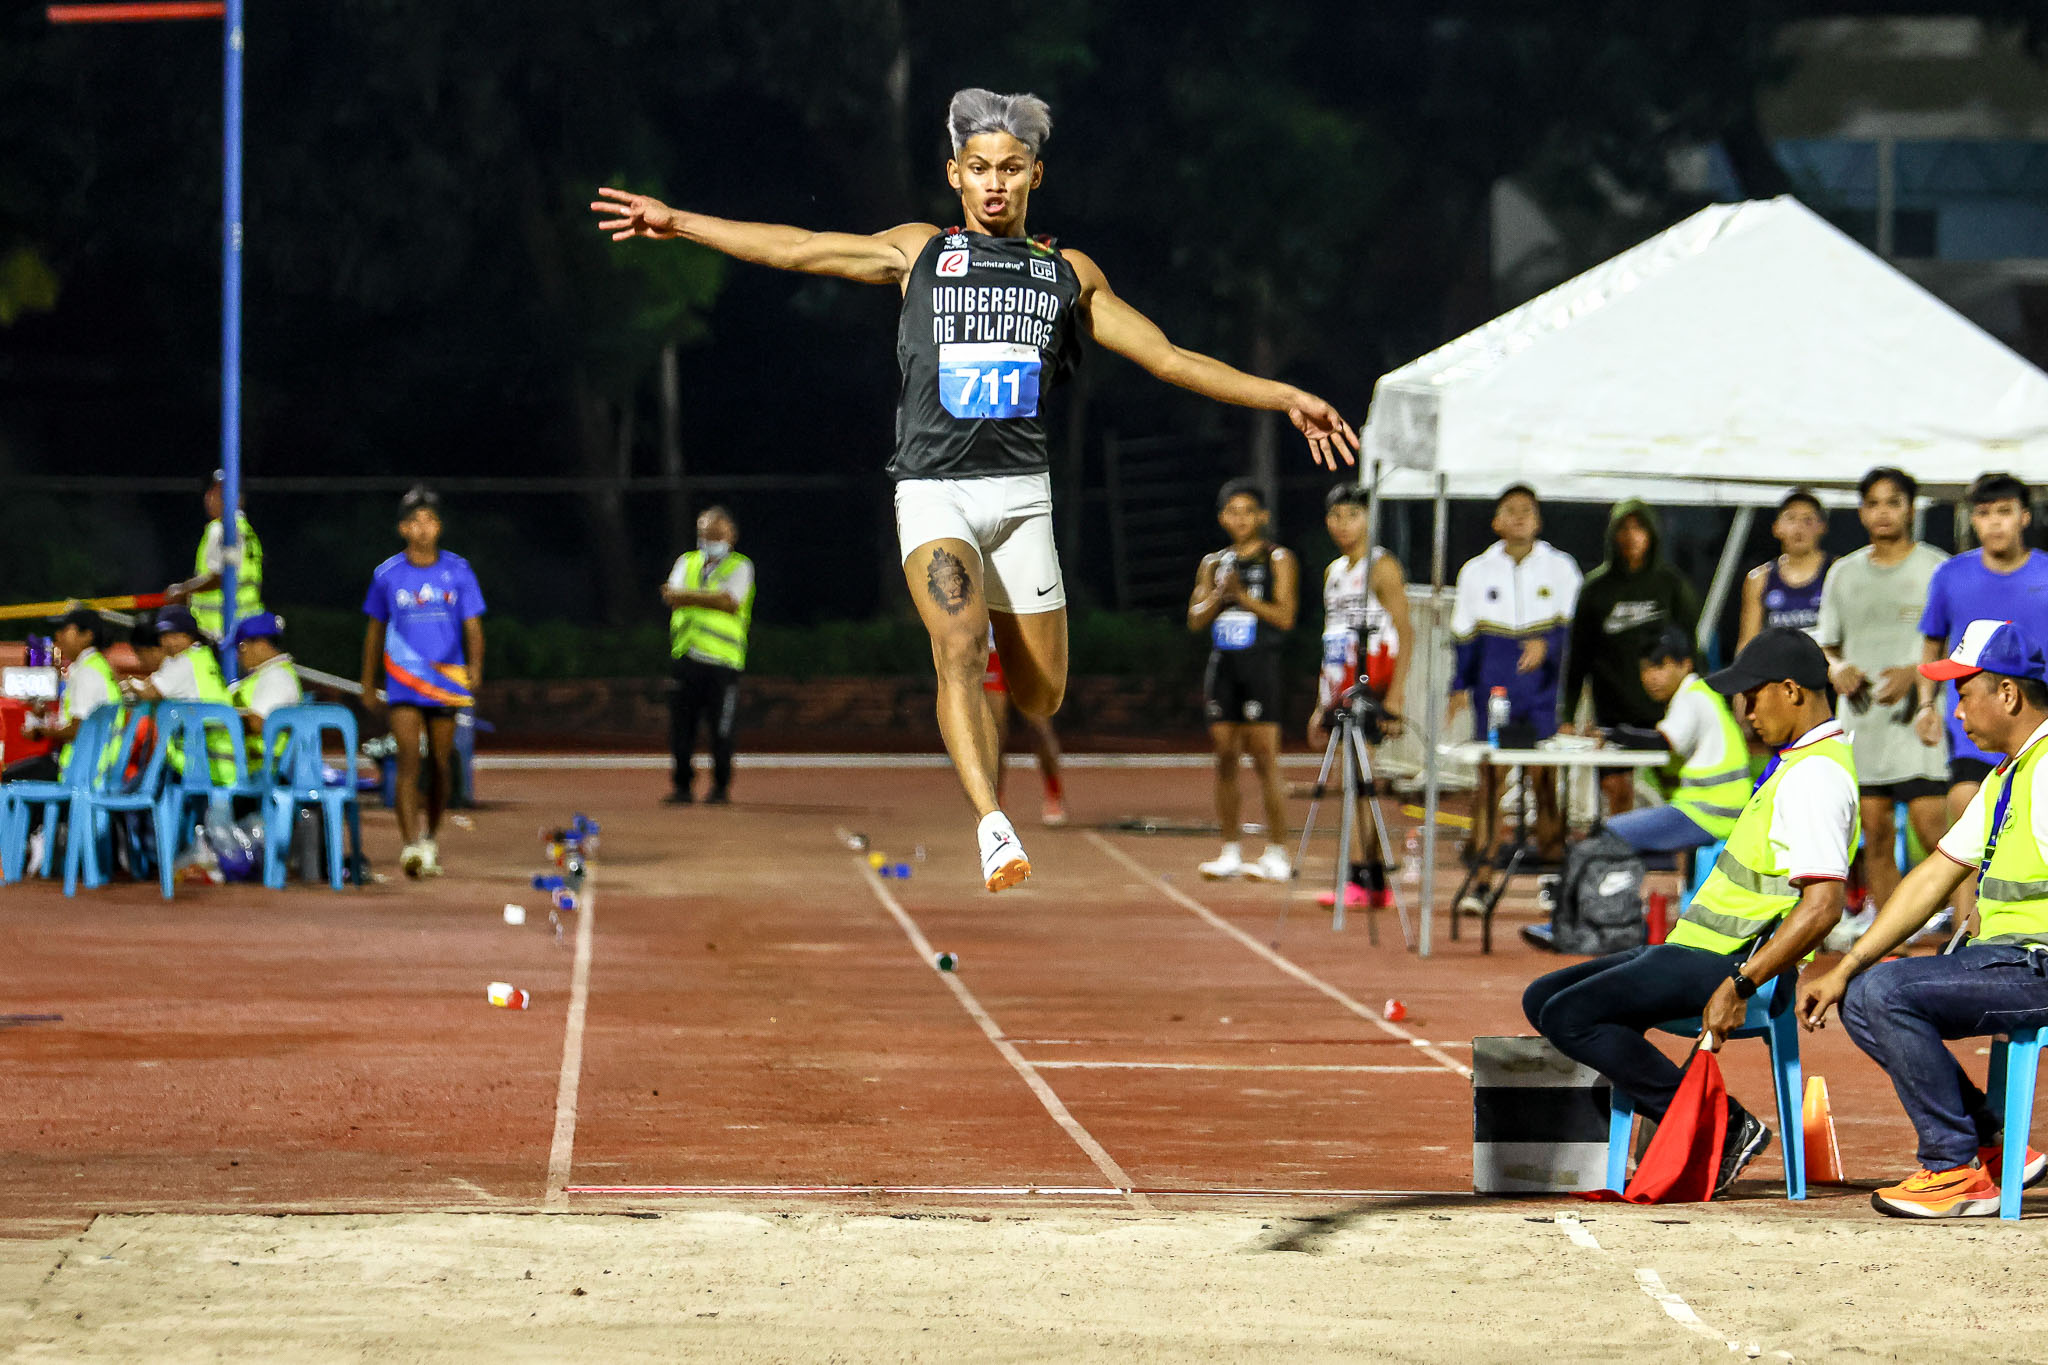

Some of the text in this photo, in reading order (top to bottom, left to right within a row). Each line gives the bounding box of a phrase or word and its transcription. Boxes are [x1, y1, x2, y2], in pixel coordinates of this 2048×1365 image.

[1034, 266, 1053, 277] UP
[932, 286, 1059, 321] UNIBERSIDAD
[933, 314, 1053, 349] NG PILIPINAS
[955, 368, 1020, 406] 711
